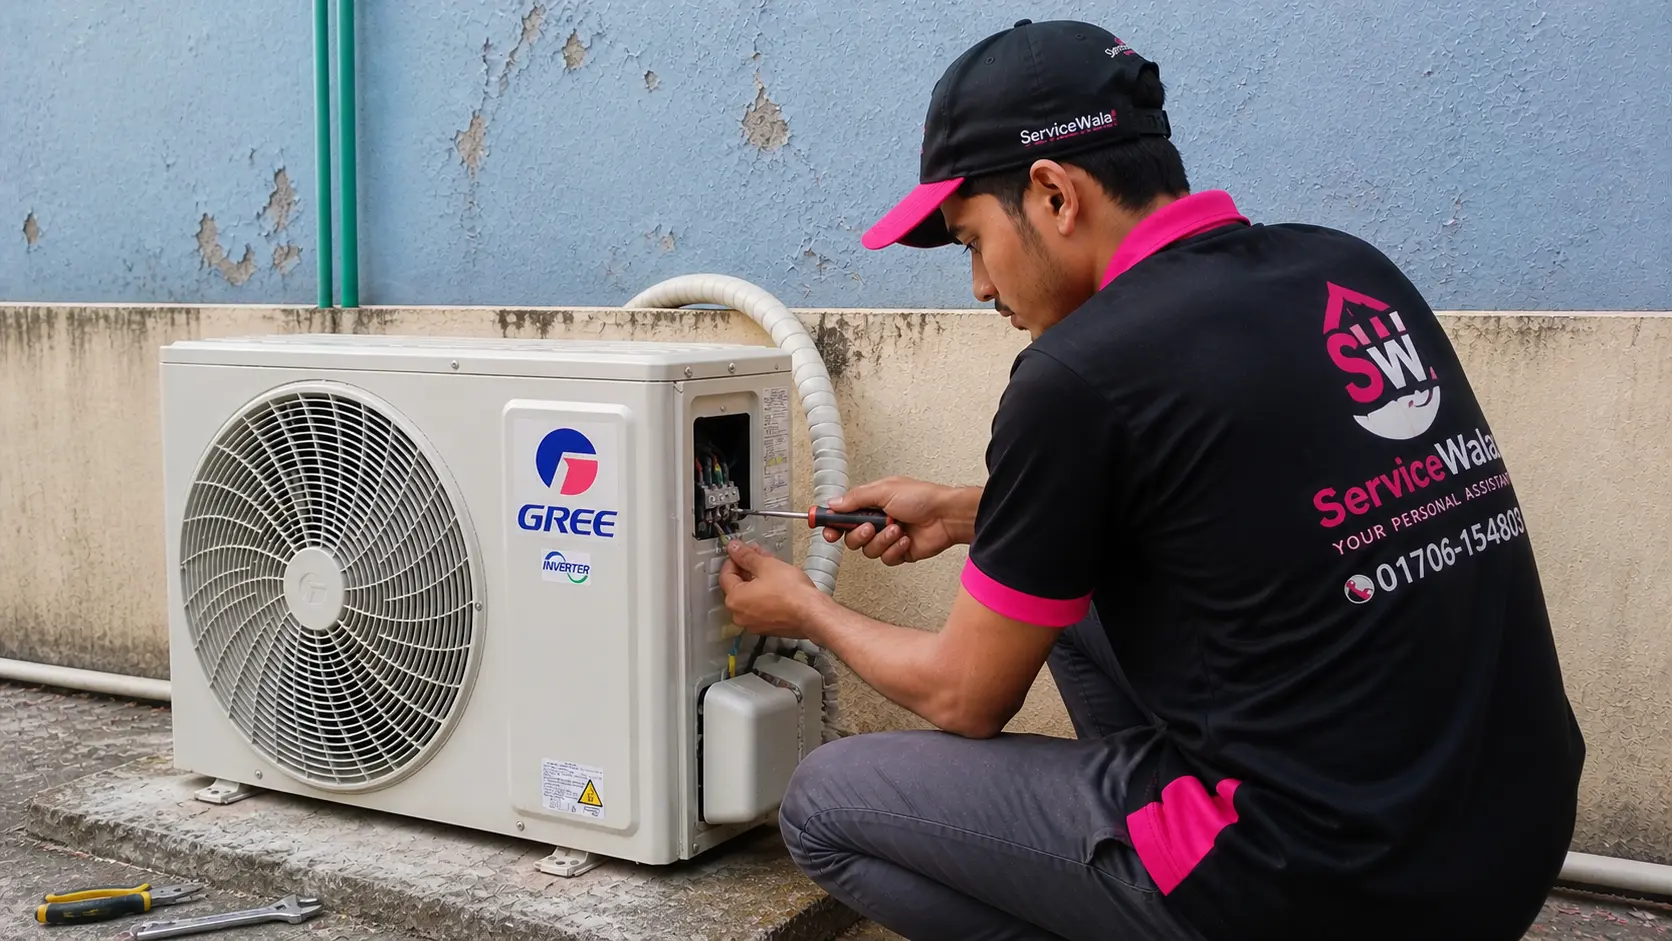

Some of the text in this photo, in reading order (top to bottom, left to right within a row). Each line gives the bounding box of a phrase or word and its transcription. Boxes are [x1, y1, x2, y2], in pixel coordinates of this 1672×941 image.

[1020, 112, 1112, 144] ServiceWala
[1313, 428, 1500, 527] ServiceWala
[517, 503, 618, 538] GREE
[1332, 524, 1387, 555] YOUR
[1391, 493, 1462, 532] PERSONAL
[542, 560, 590, 575] INVERTER
[1375, 507, 1525, 592] 01706-154803
